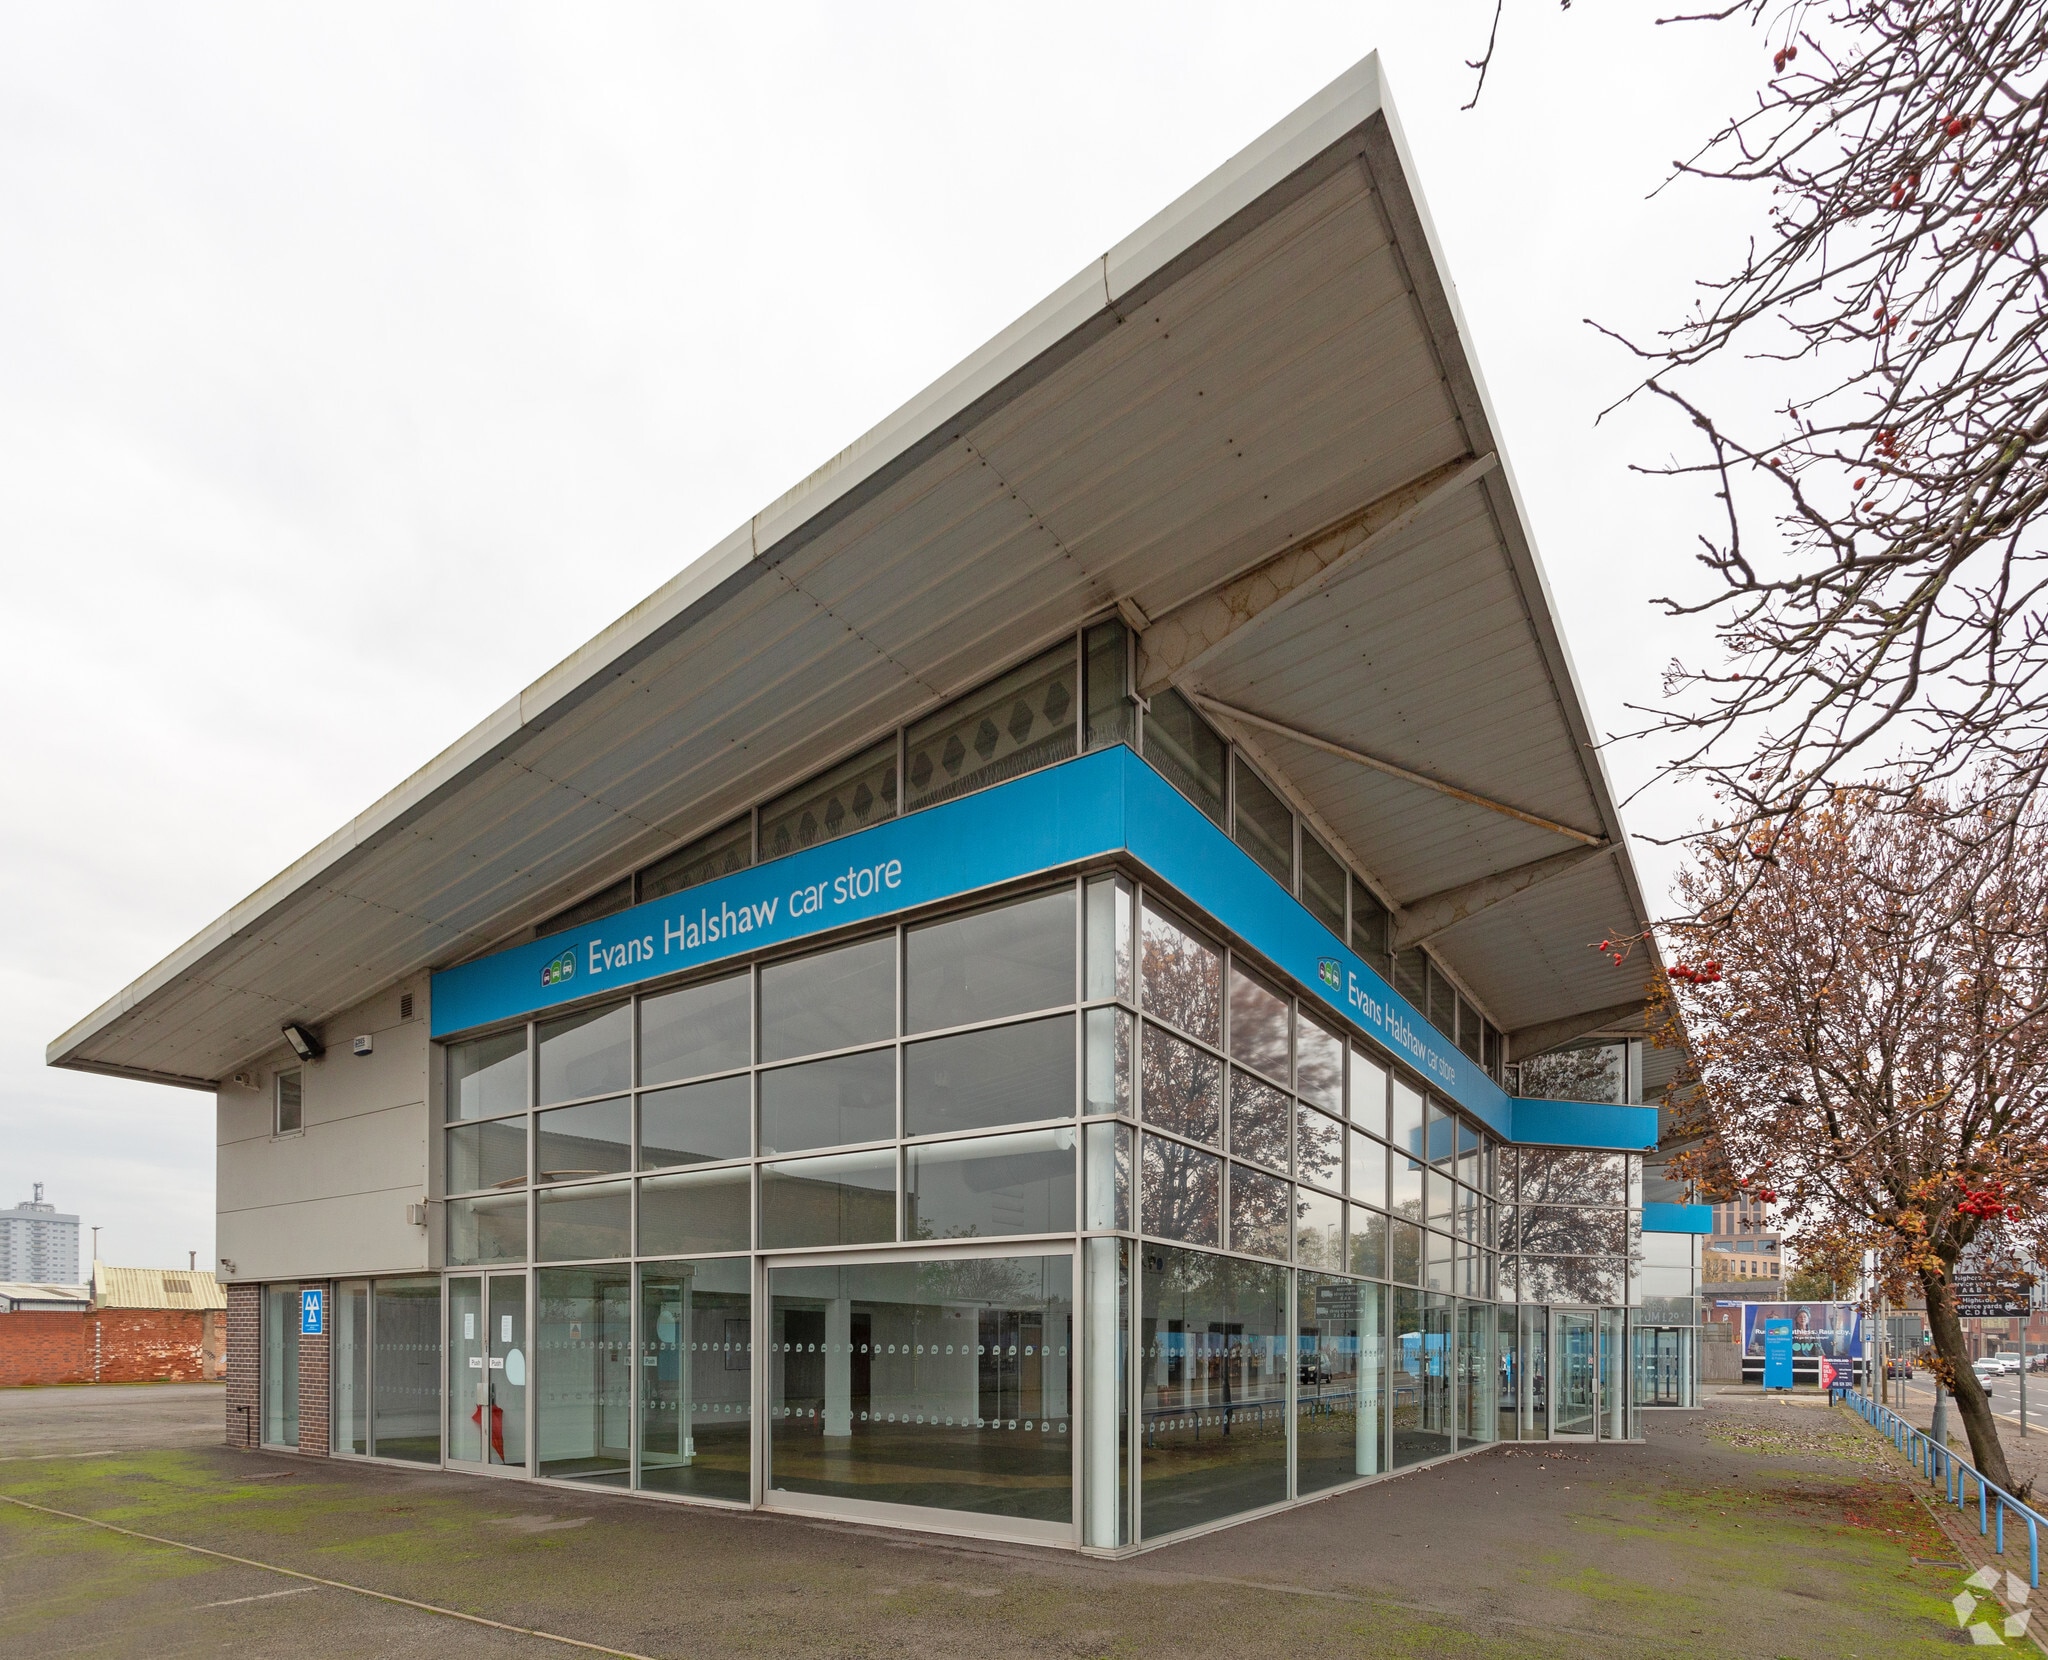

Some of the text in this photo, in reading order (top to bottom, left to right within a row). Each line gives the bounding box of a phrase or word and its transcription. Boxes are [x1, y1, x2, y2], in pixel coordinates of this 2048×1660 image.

[589, 859, 902, 975] Evans Halshaw car store
[1348, 971, 1456, 1085] Evans Halshaw car store
[491, 1359, 502, 1367] Push
[1792, 1342, 1814, 1352] OW
